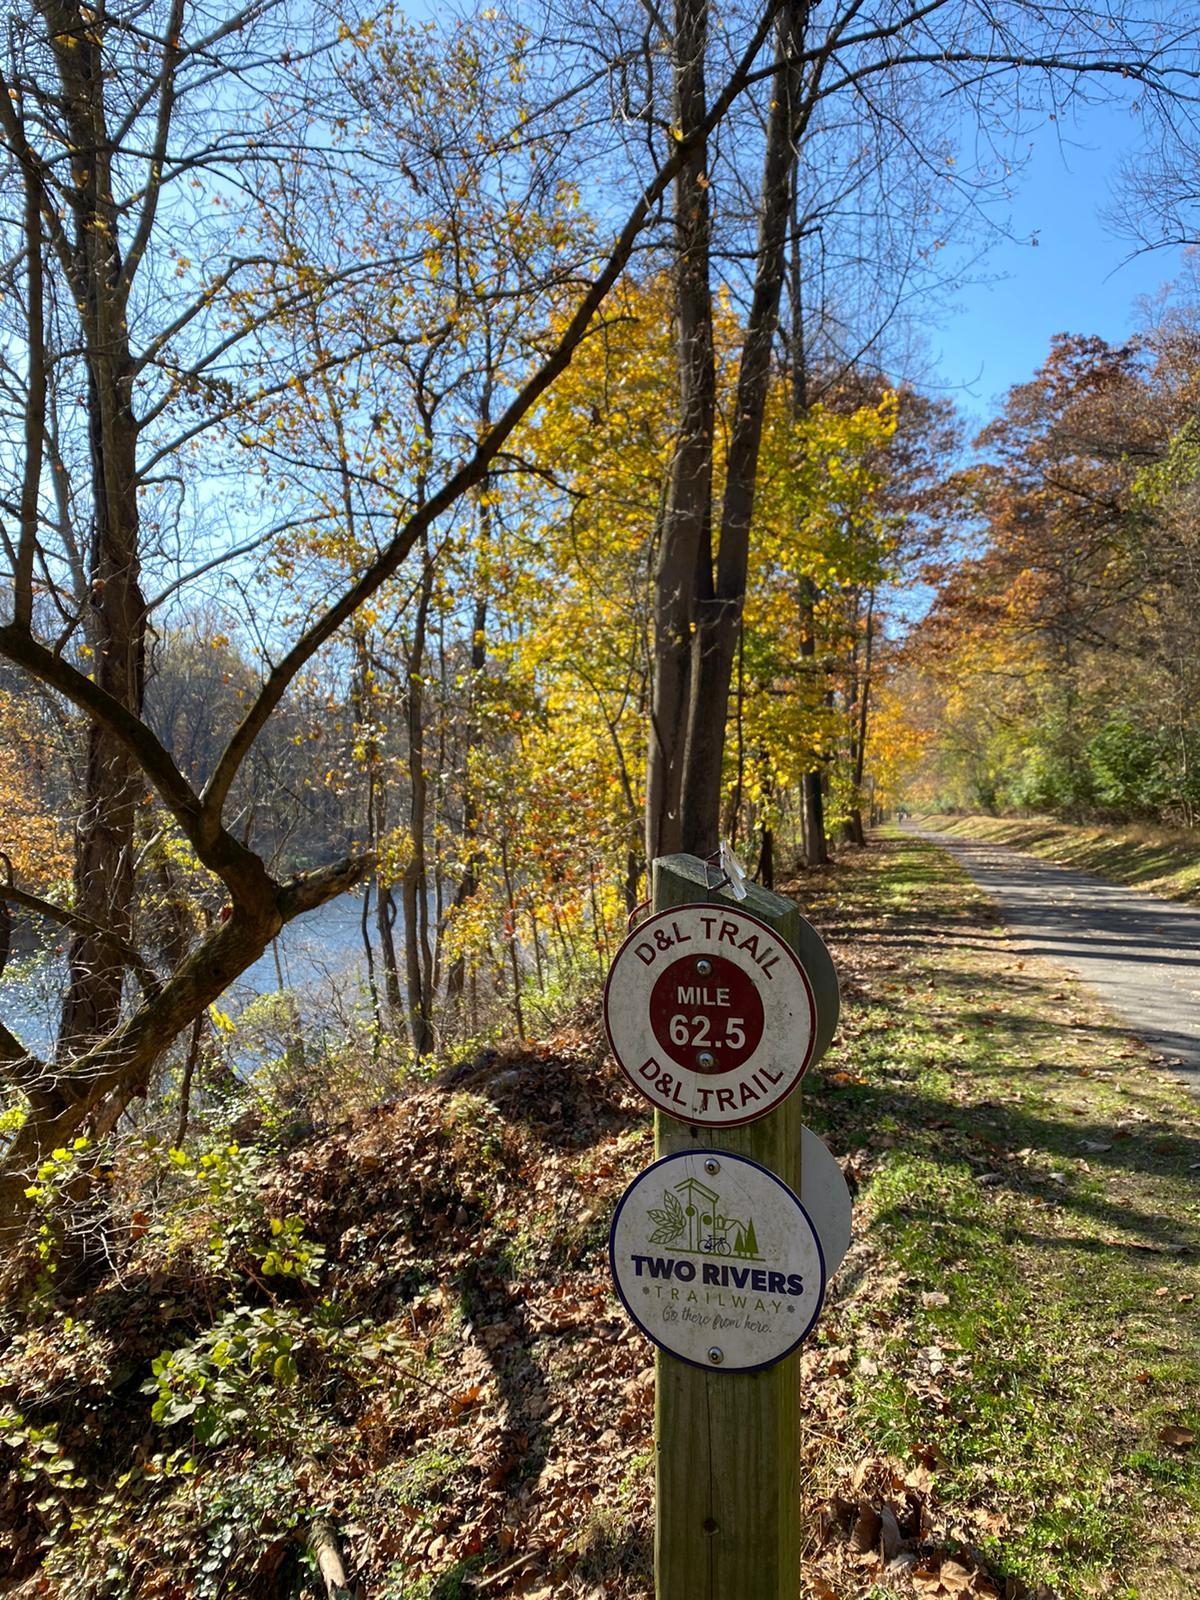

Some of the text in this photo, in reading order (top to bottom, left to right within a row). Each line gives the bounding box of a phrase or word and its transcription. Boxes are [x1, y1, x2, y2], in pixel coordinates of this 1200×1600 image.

[634, 917, 781, 980] D&L TRAIL
[677, 986, 731, 1007] MILE
[669, 1014, 746, 1049] 62.5
[638, 1056, 784, 1112] D&L TRAIL
[631, 1254, 804, 1296] TWO RIVERS
[655, 1285, 783, 1314] TRAILWAY
[662, 1304, 677, 1322] Go
[681, 1306, 710, 1325] there
[712, 1314, 741, 1330] from
